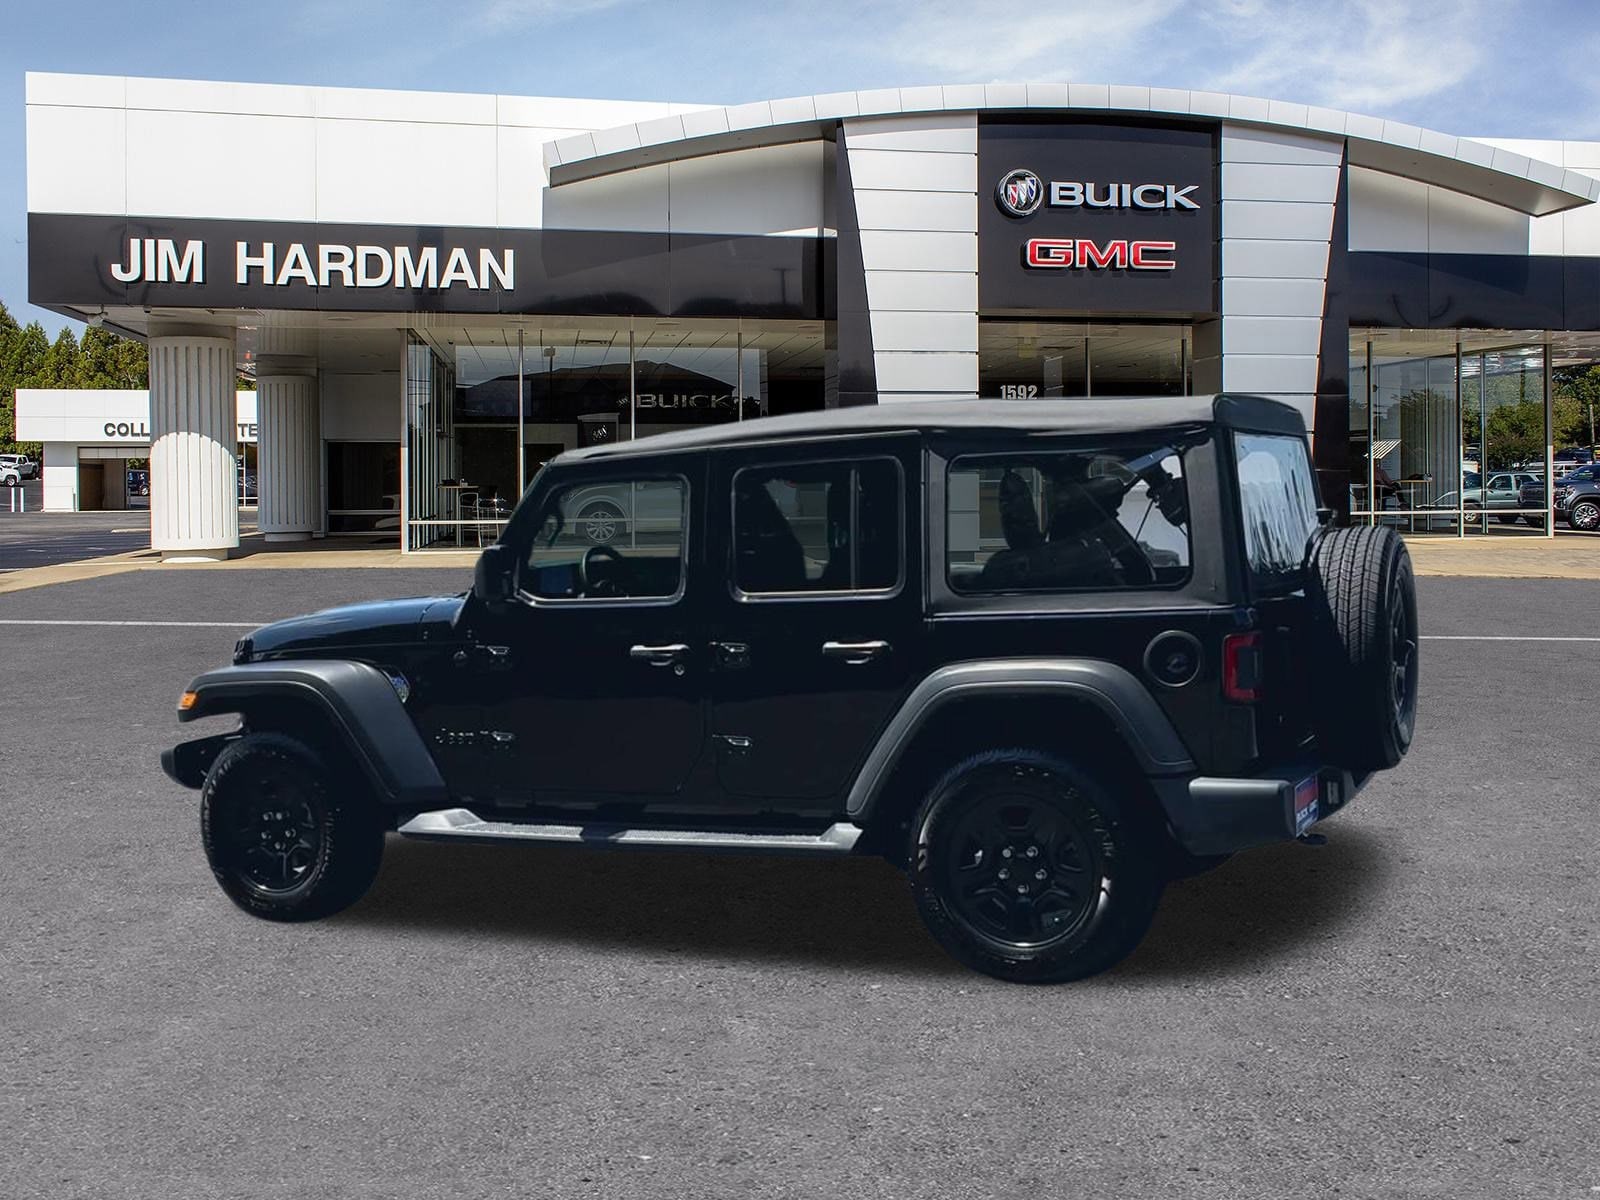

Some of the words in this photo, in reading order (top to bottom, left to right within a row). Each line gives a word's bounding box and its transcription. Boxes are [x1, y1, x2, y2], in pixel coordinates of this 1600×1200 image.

[1050, 181, 1201, 209] BUICK
[111, 238, 204, 284] JIM
[236, 241, 515, 291] HARDMAN
[1025, 238, 1177, 270] GMC
[635, 393, 732, 409] BUICK
[1000, 384, 1038, 400] 1592
